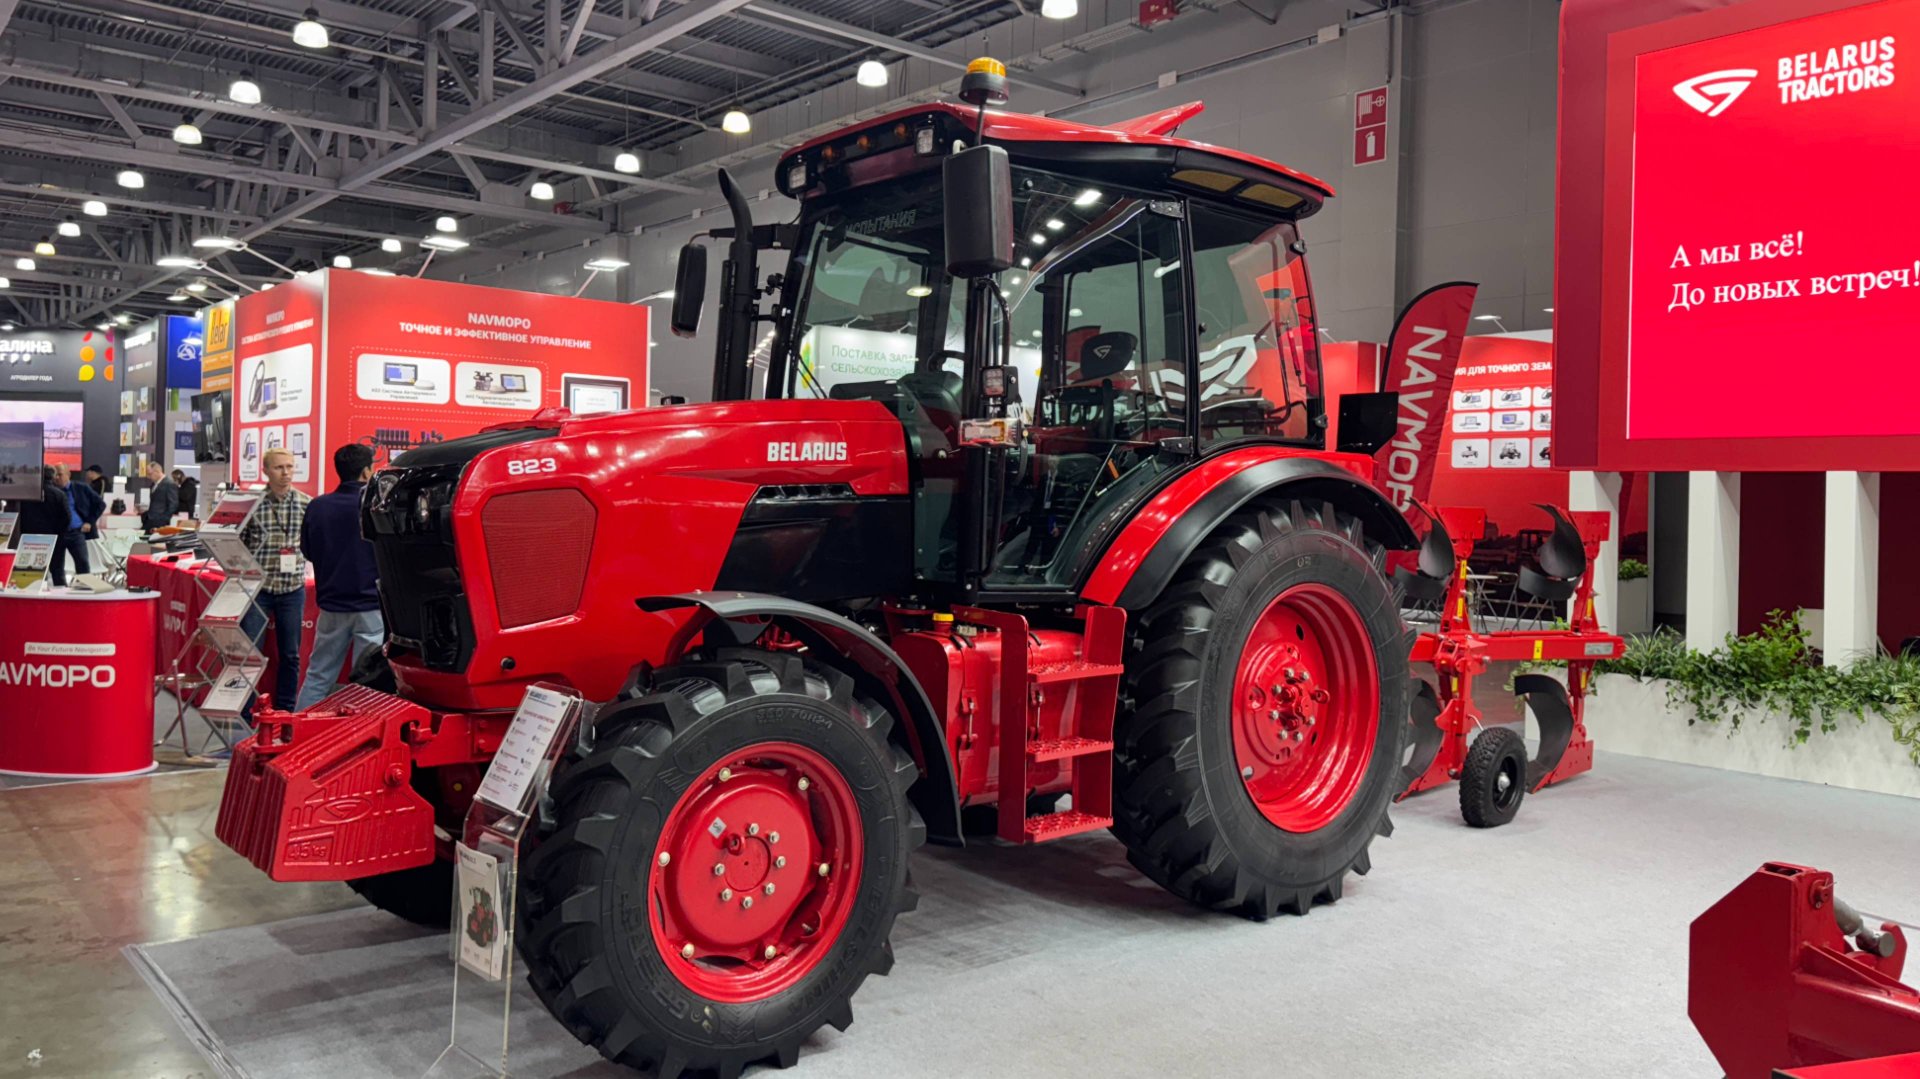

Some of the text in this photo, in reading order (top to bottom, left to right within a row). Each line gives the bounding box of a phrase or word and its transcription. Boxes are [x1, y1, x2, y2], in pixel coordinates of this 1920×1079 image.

[1778, 36, 1895, 81] BELARUS
[1778, 62, 1895, 105] TRACTORS
[1670, 230, 1803, 268] А мы всё!
[1668, 260, 1920, 313] До новых встреч!
[467, 312, 532, 330] NAVMOPO
[399, 322, 592, 350] ТОЧНОЕ И ЭФФЕКТИВНОЕ УПРАВЛЕНИЕ
[1468, 366, 1486, 376] ДЛЯ
[1487, 363, 1530, 374] ТОЧНОГО
[767, 442, 847, 461] BELARUS
[507, 458, 557, 475] 823
[0, 661, 116, 688] AVMOPO
